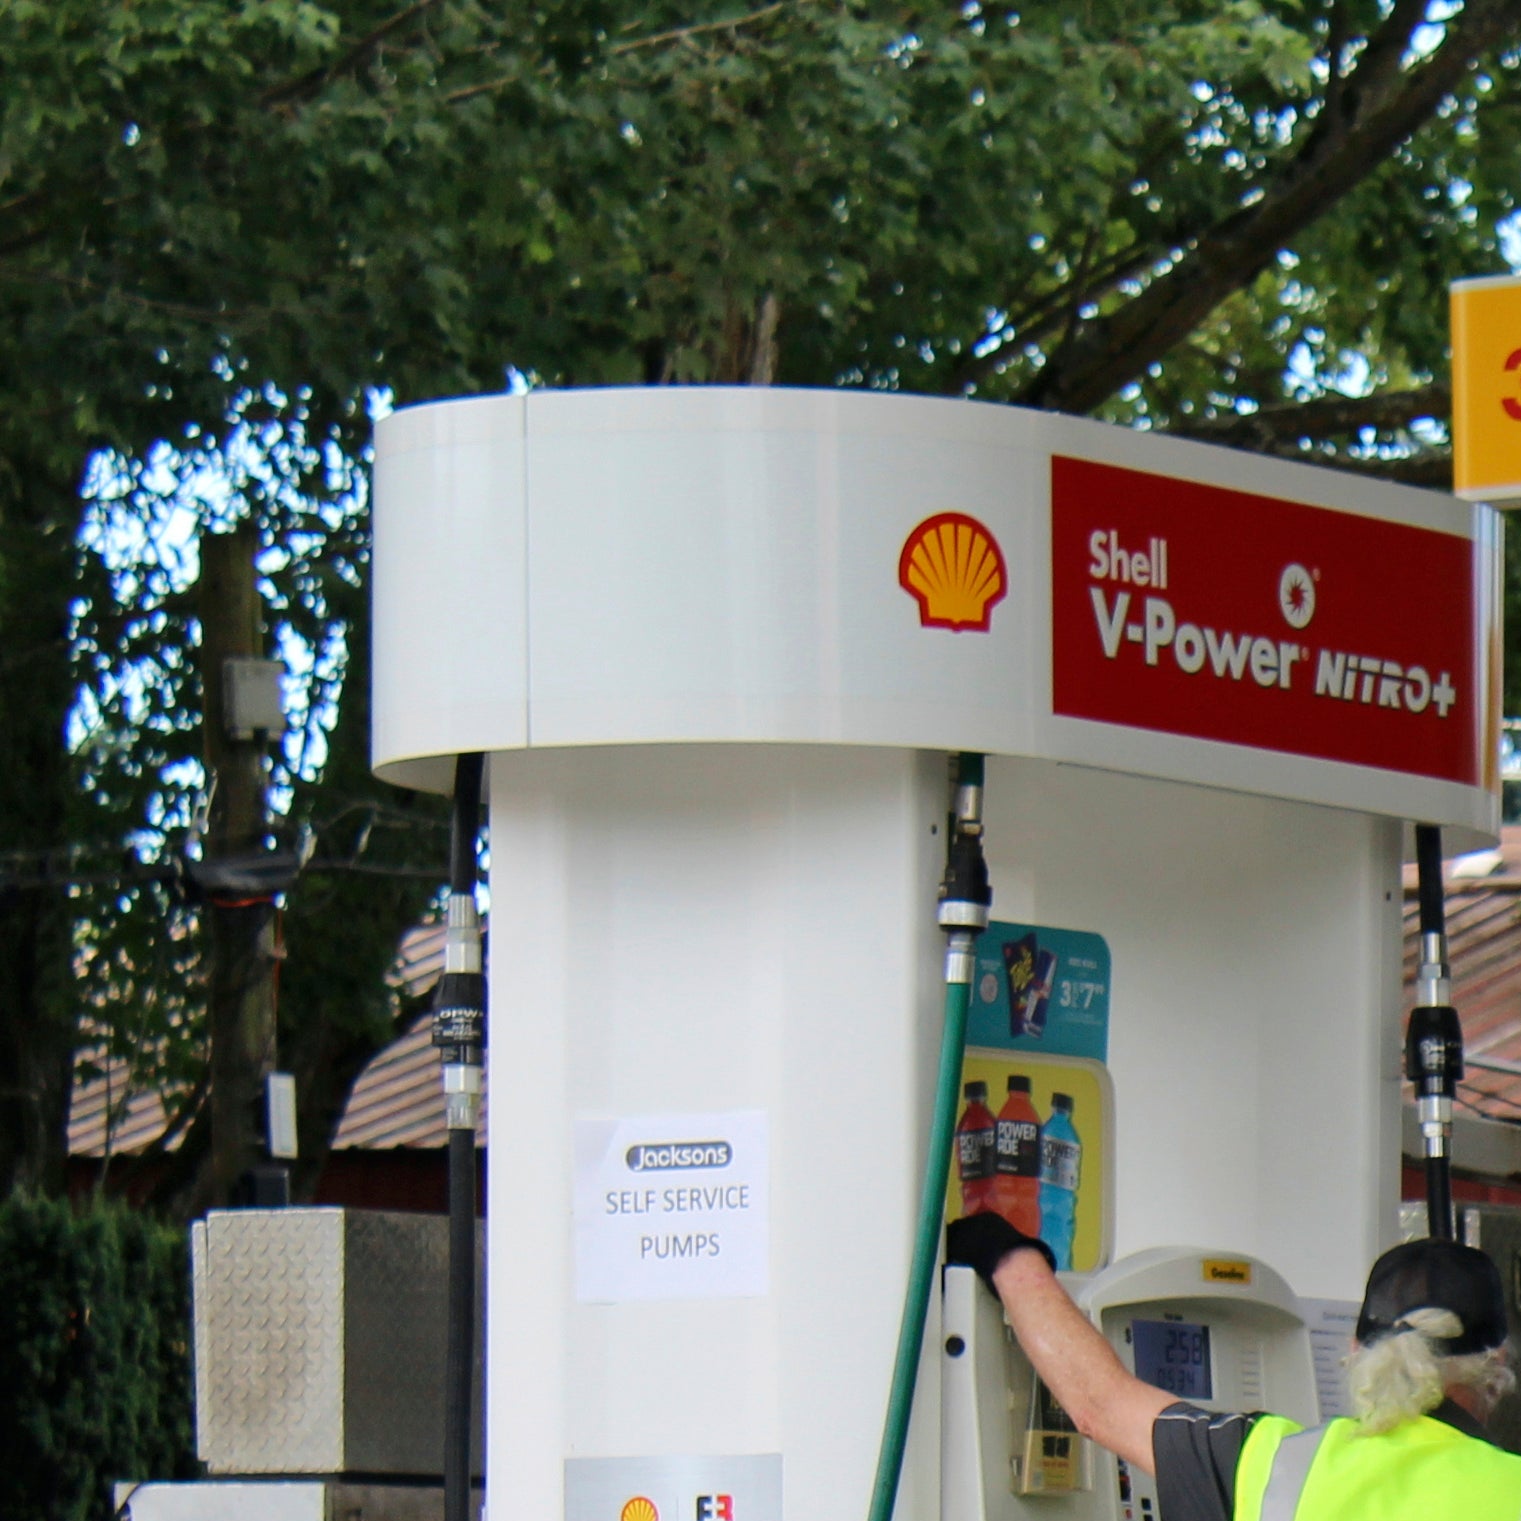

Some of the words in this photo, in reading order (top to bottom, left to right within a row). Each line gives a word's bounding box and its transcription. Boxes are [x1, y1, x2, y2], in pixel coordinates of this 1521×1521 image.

[1089, 529, 1168, 590] Shell
[1089, 585, 1300, 690] V-Power
[997, 1121, 1037, 1141] POWER
[633, 1146, 728, 1170] Jacksons
[605, 1190, 656, 1215] SELF
[663, 1186, 750, 1212] SERVICE
[640, 1233, 721, 1259] PUMPS
